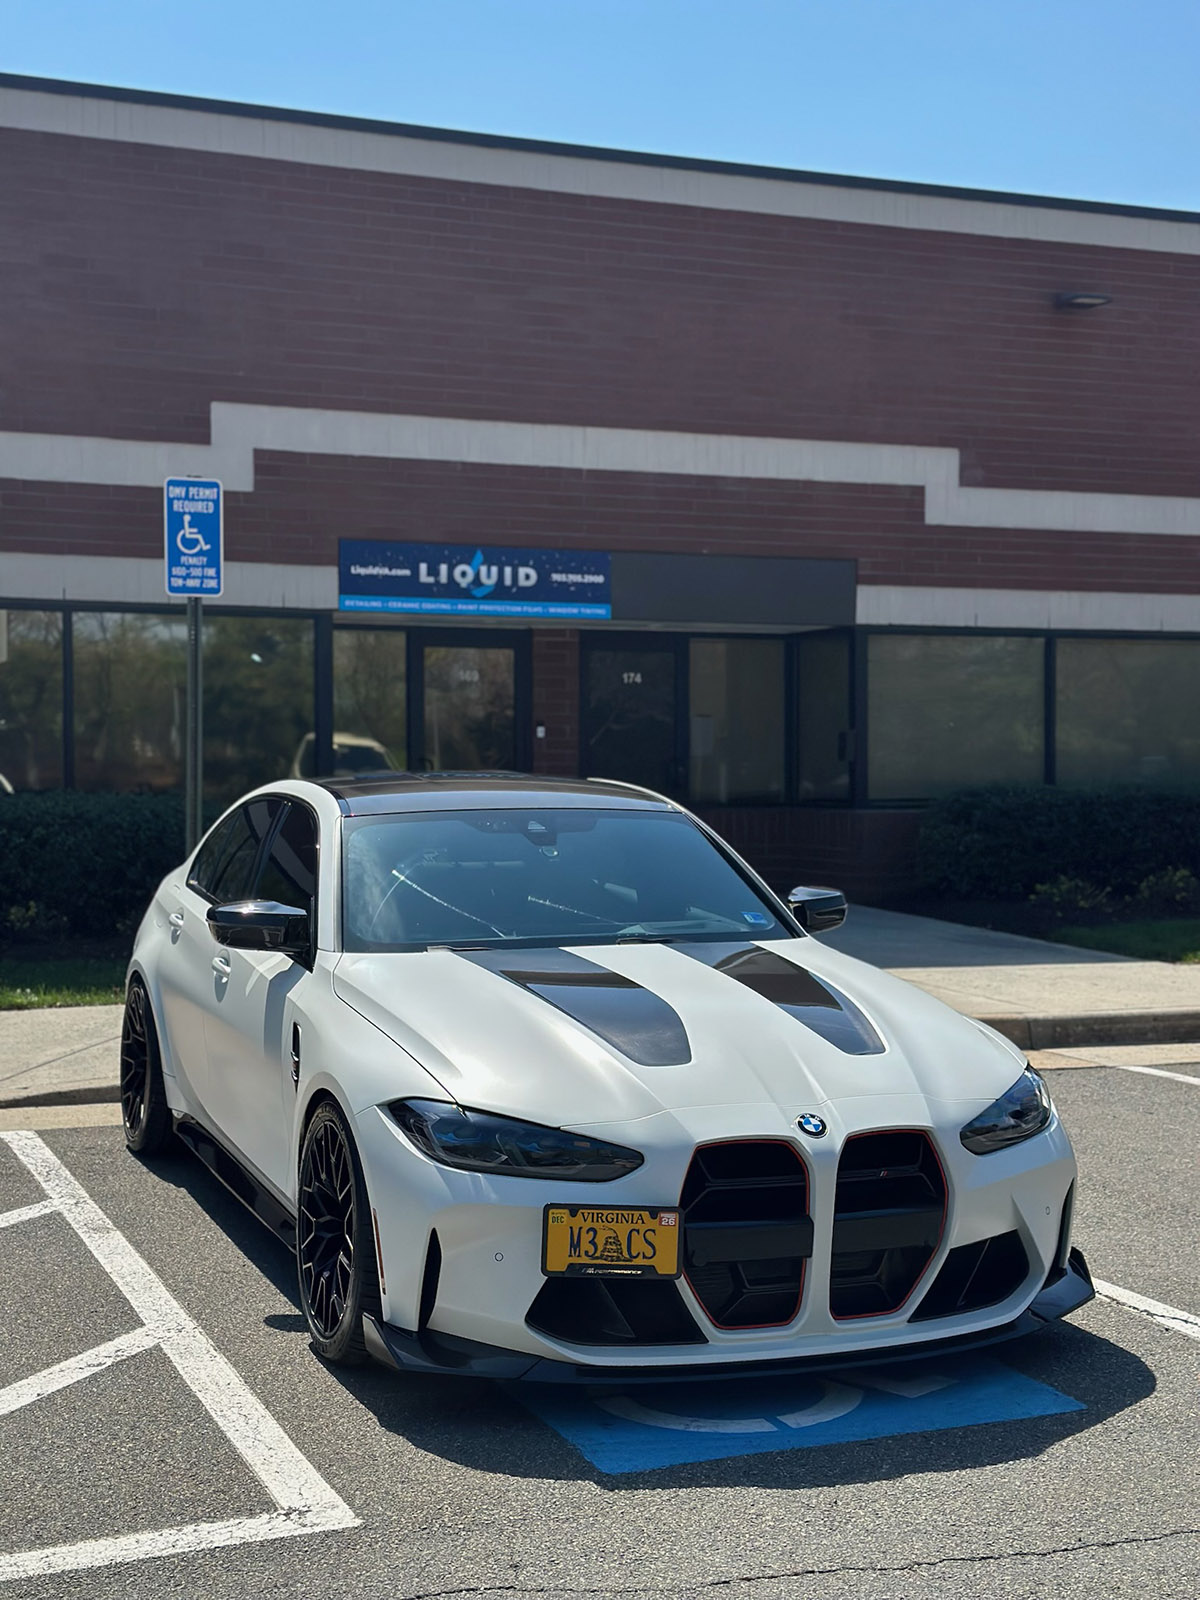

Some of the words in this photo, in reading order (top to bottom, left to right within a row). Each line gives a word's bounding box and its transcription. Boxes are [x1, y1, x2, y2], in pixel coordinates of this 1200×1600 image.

[168, 486, 186, 498] DMV
[189, 487, 218, 500] PERMIT
[173, 499, 214, 513] REQUIRED
[180, 555, 208, 566] PENALTY
[419, 562, 538, 588] LIQUID
[344, 599, 382, 608] DETAILING
[387, 600, 420, 610] CERAMIC
[421, 602, 452, 611] COATING
[457, 603, 478, 611] PAINT
[479, 604, 522, 614] PROTECTION
[548, 607, 579, 615] WINDOW
[580, 607, 606, 616] TINTING
[622, 671, 642, 684] 174
[551, 1215, 565, 1224] DEC
[580, 1211, 645, 1225] VIRGINIA
[661, 1217, 675, 1225] 26
[568, 1226, 598, 1257] M3
[626, 1228, 657, 1260] CS
